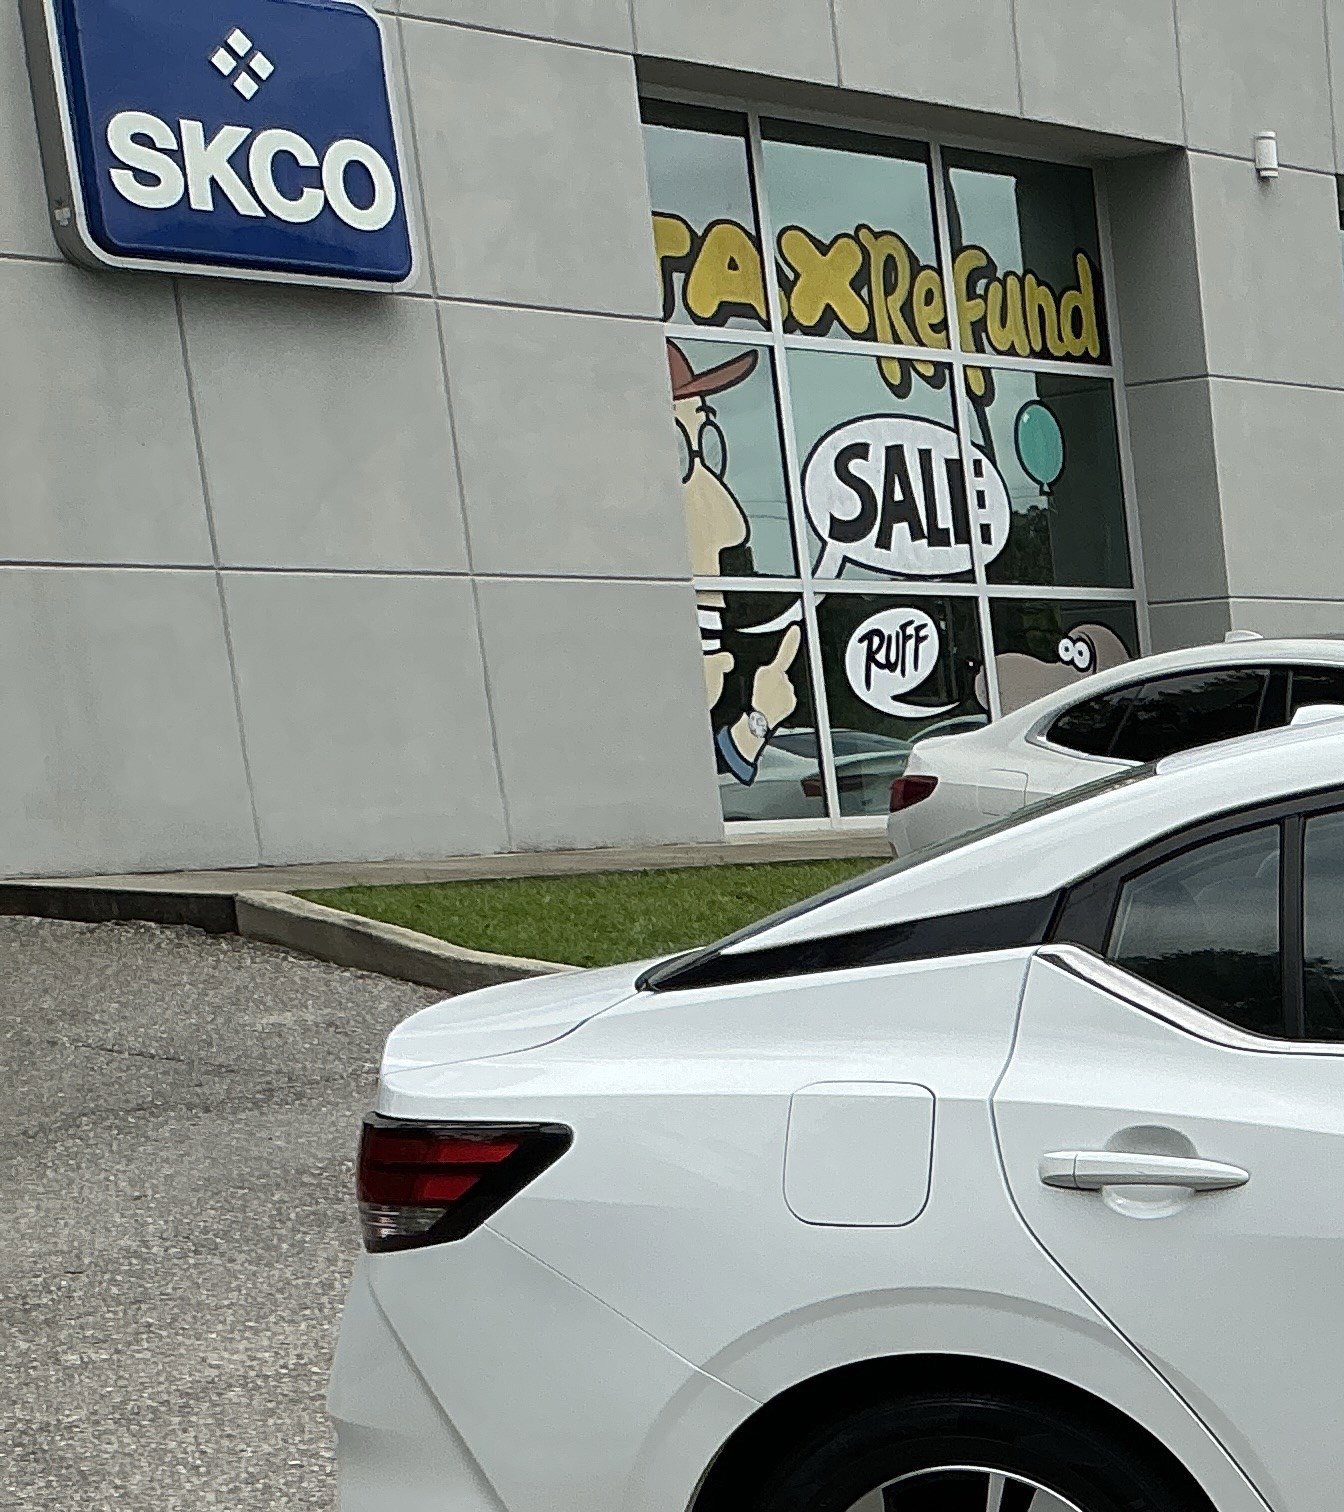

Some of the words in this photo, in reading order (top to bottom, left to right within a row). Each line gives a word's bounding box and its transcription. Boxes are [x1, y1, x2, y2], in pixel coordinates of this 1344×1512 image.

[106, 110, 397, 231] SKCO
[652, 211, 872, 336] TAX
[854, 224, 1101, 396] Refund
[828, 442, 992, 551] SALE
[858, 618, 930, 692] RUFF
